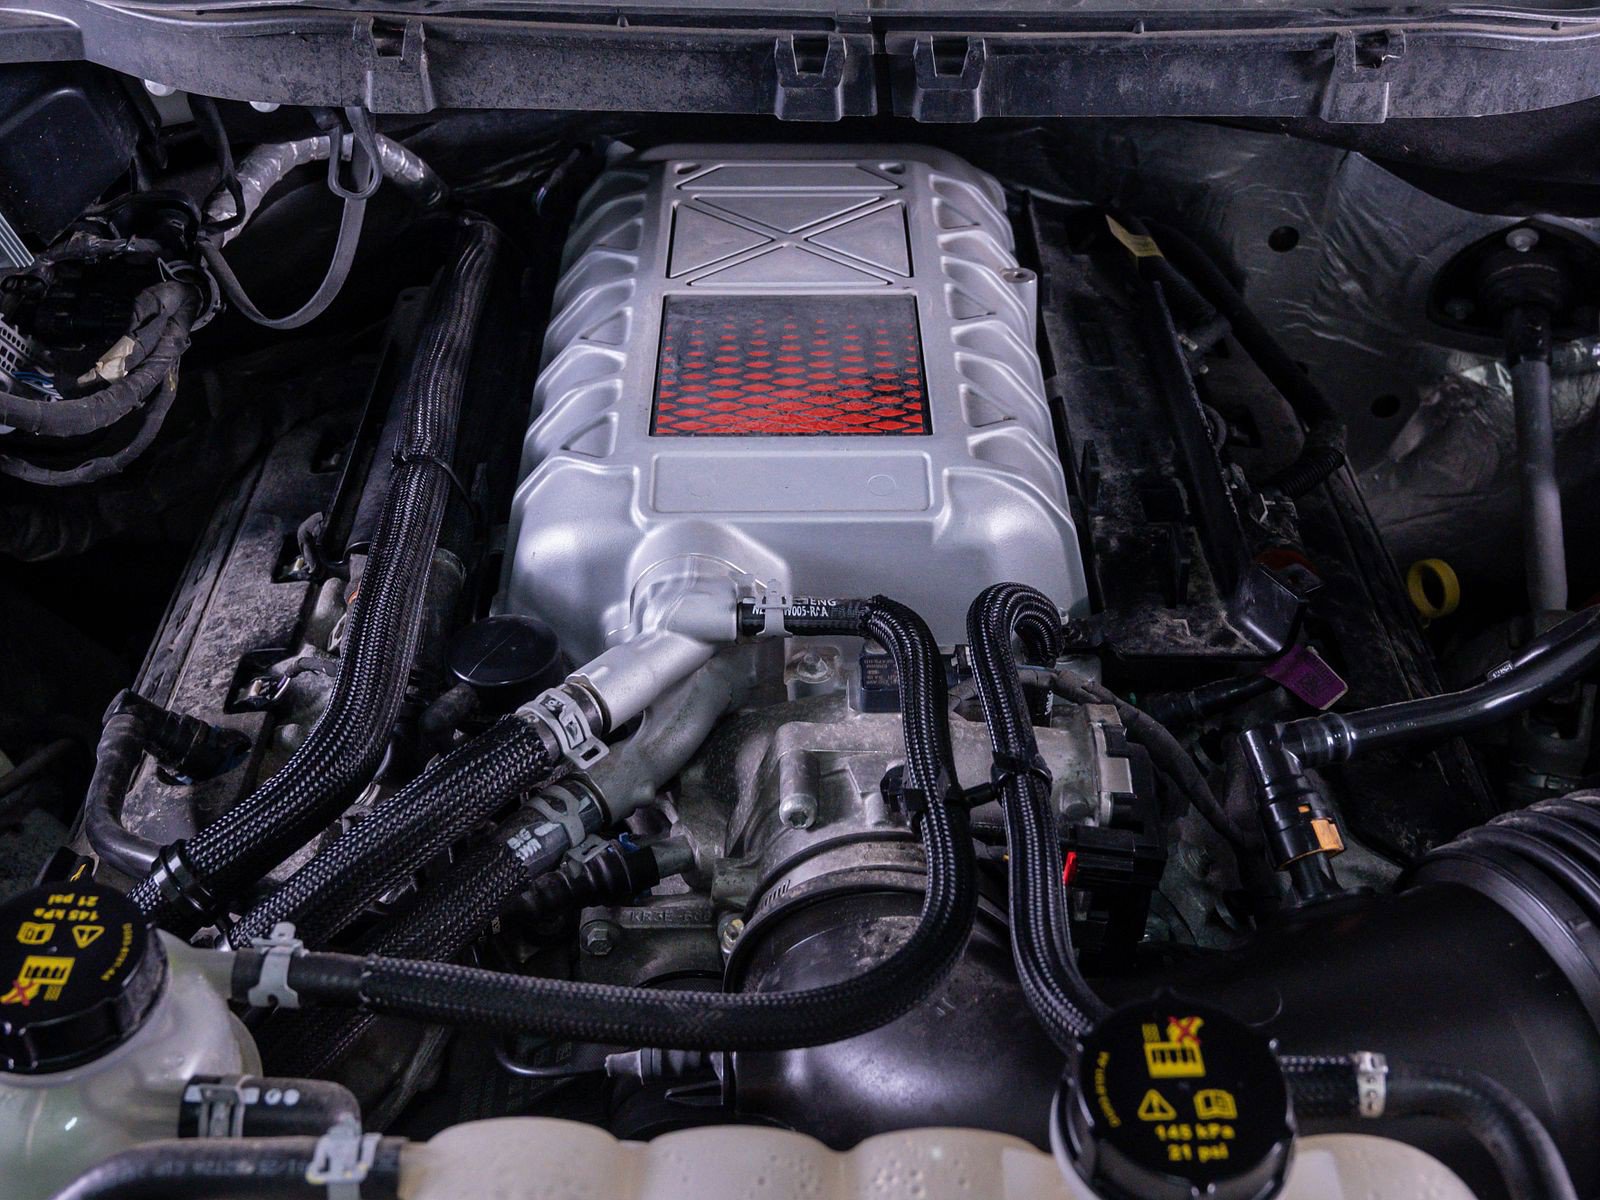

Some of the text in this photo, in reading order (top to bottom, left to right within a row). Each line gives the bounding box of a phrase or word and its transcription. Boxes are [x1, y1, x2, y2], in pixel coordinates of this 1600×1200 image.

[47, 892, 99, 908] 21 psi
[33, 907, 99, 922] 145 kPa
[1154, 1122, 1236, 1141] 145 kPa
[1167, 1141, 1229, 1164] 21 psi
